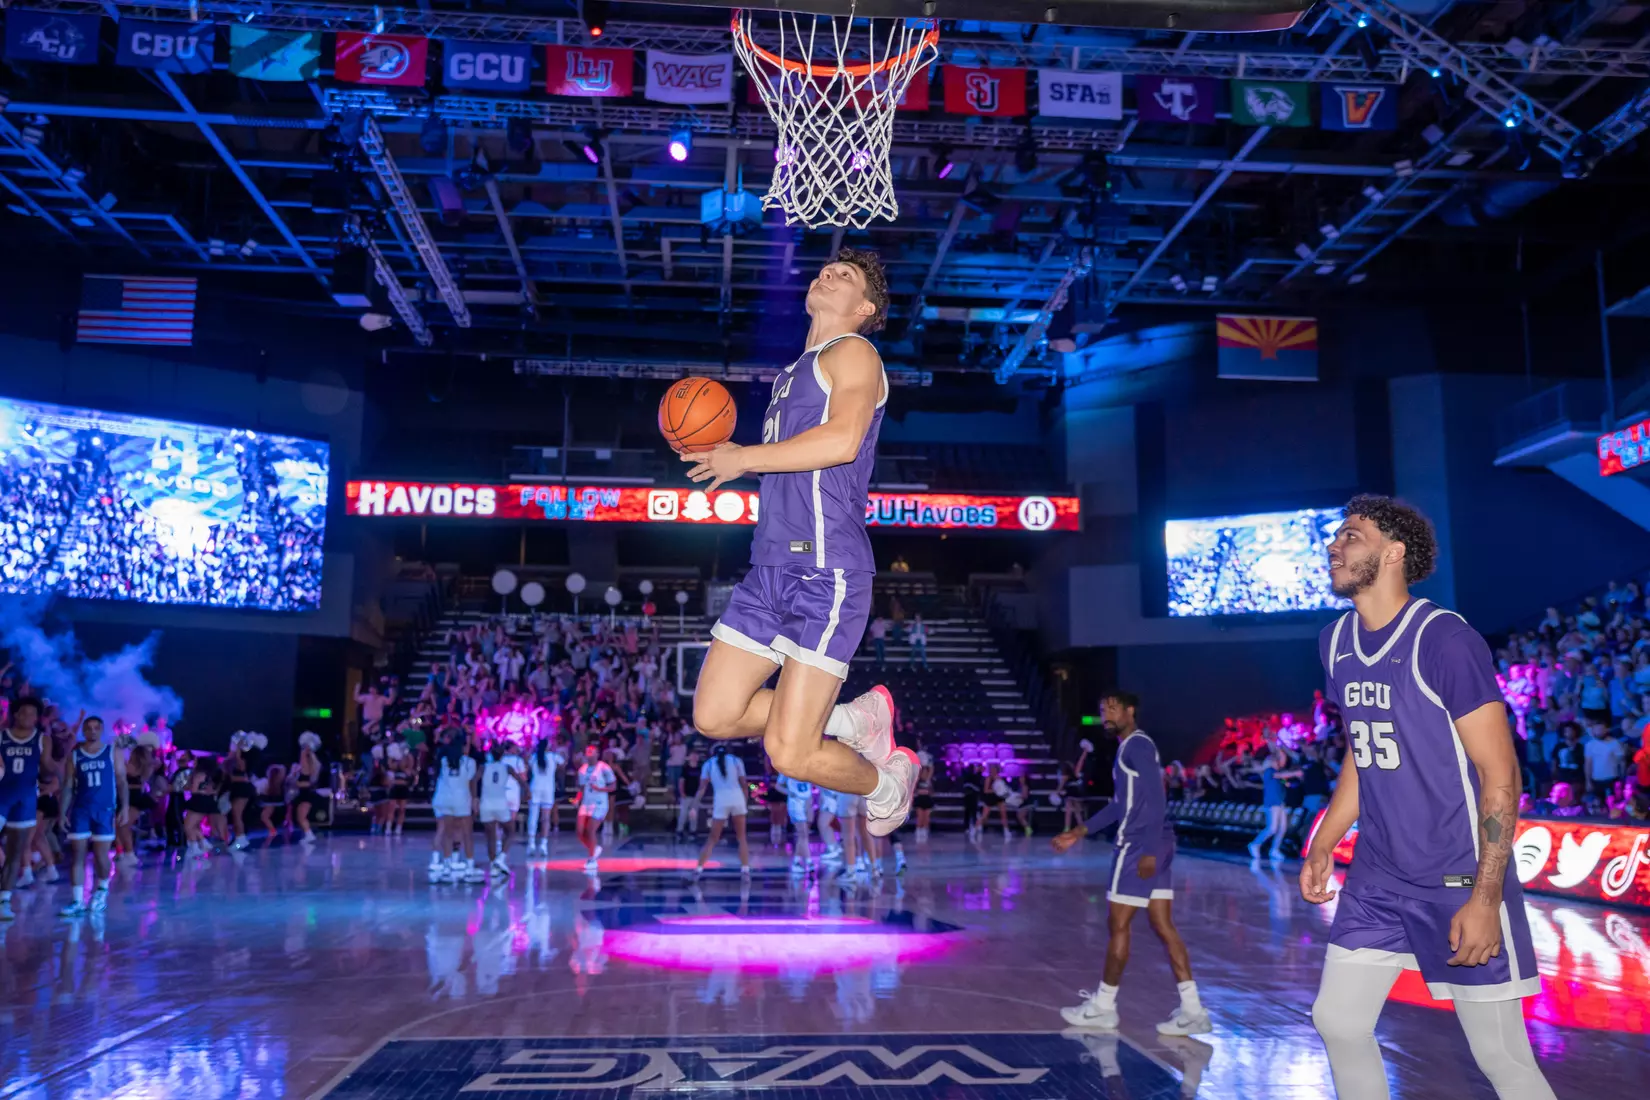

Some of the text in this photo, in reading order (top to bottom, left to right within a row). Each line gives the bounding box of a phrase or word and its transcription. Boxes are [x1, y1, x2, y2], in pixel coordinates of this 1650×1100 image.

[27, 30, 77, 59] ACU
[131, 31, 199, 59] CBU
[450, 52, 525, 84] GCU
[653, 61, 726, 89] WAC
[355, 482, 496, 515] HAVOCS
[520, 487, 621, 508] FOLLOW
[1344, 681, 1391, 711] GCU
[1350, 720, 1401, 770] 35
[12, 757, 25, 774] 0
[87, 771, 102, 787] 11
